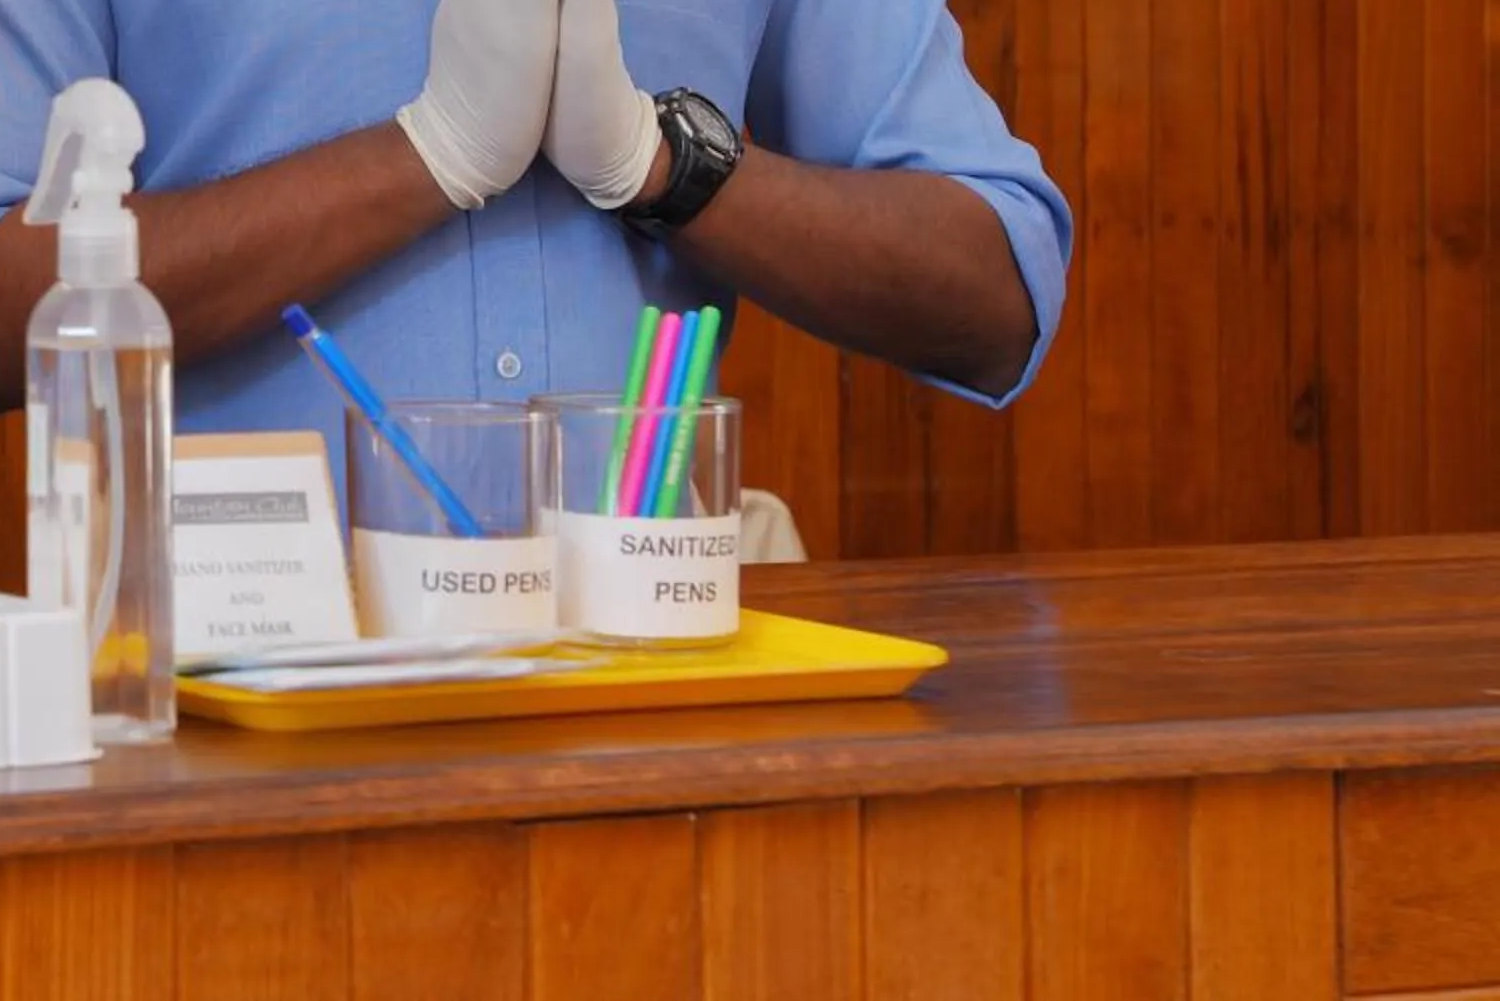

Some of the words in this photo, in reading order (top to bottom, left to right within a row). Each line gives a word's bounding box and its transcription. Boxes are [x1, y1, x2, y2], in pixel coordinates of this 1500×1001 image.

[421, 569, 496, 595] USED
[504, 571, 551, 593] PENS
[655, 582, 717, 602] PENS
